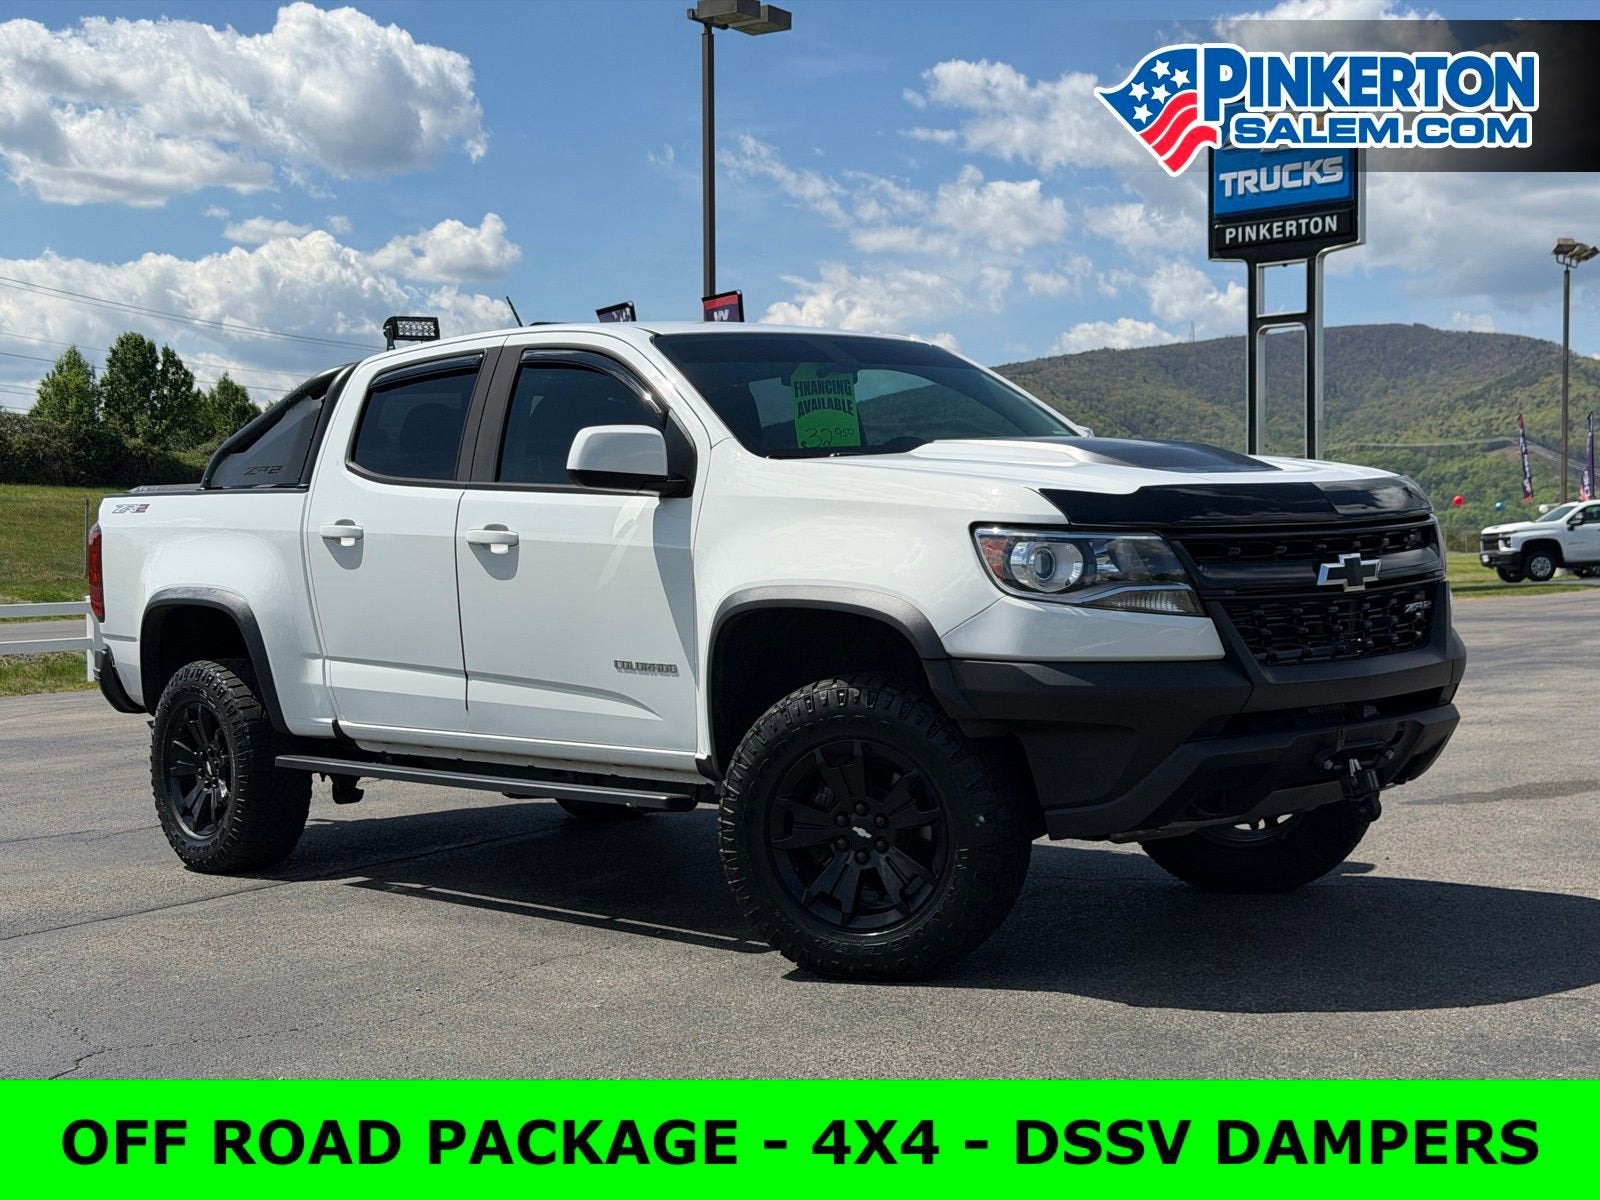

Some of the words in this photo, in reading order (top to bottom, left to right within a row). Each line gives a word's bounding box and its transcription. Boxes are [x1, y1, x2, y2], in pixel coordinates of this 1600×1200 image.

[1219, 156, 1344, 197] TRUCKS
[1225, 215, 1338, 245] PINKERTON
[794, 379, 853, 398] FINANCING
[798, 397, 854, 418] AVAILABLE
[112, 503, 150, 514] ZR2
[613, 660, 679, 674] COLORADO
